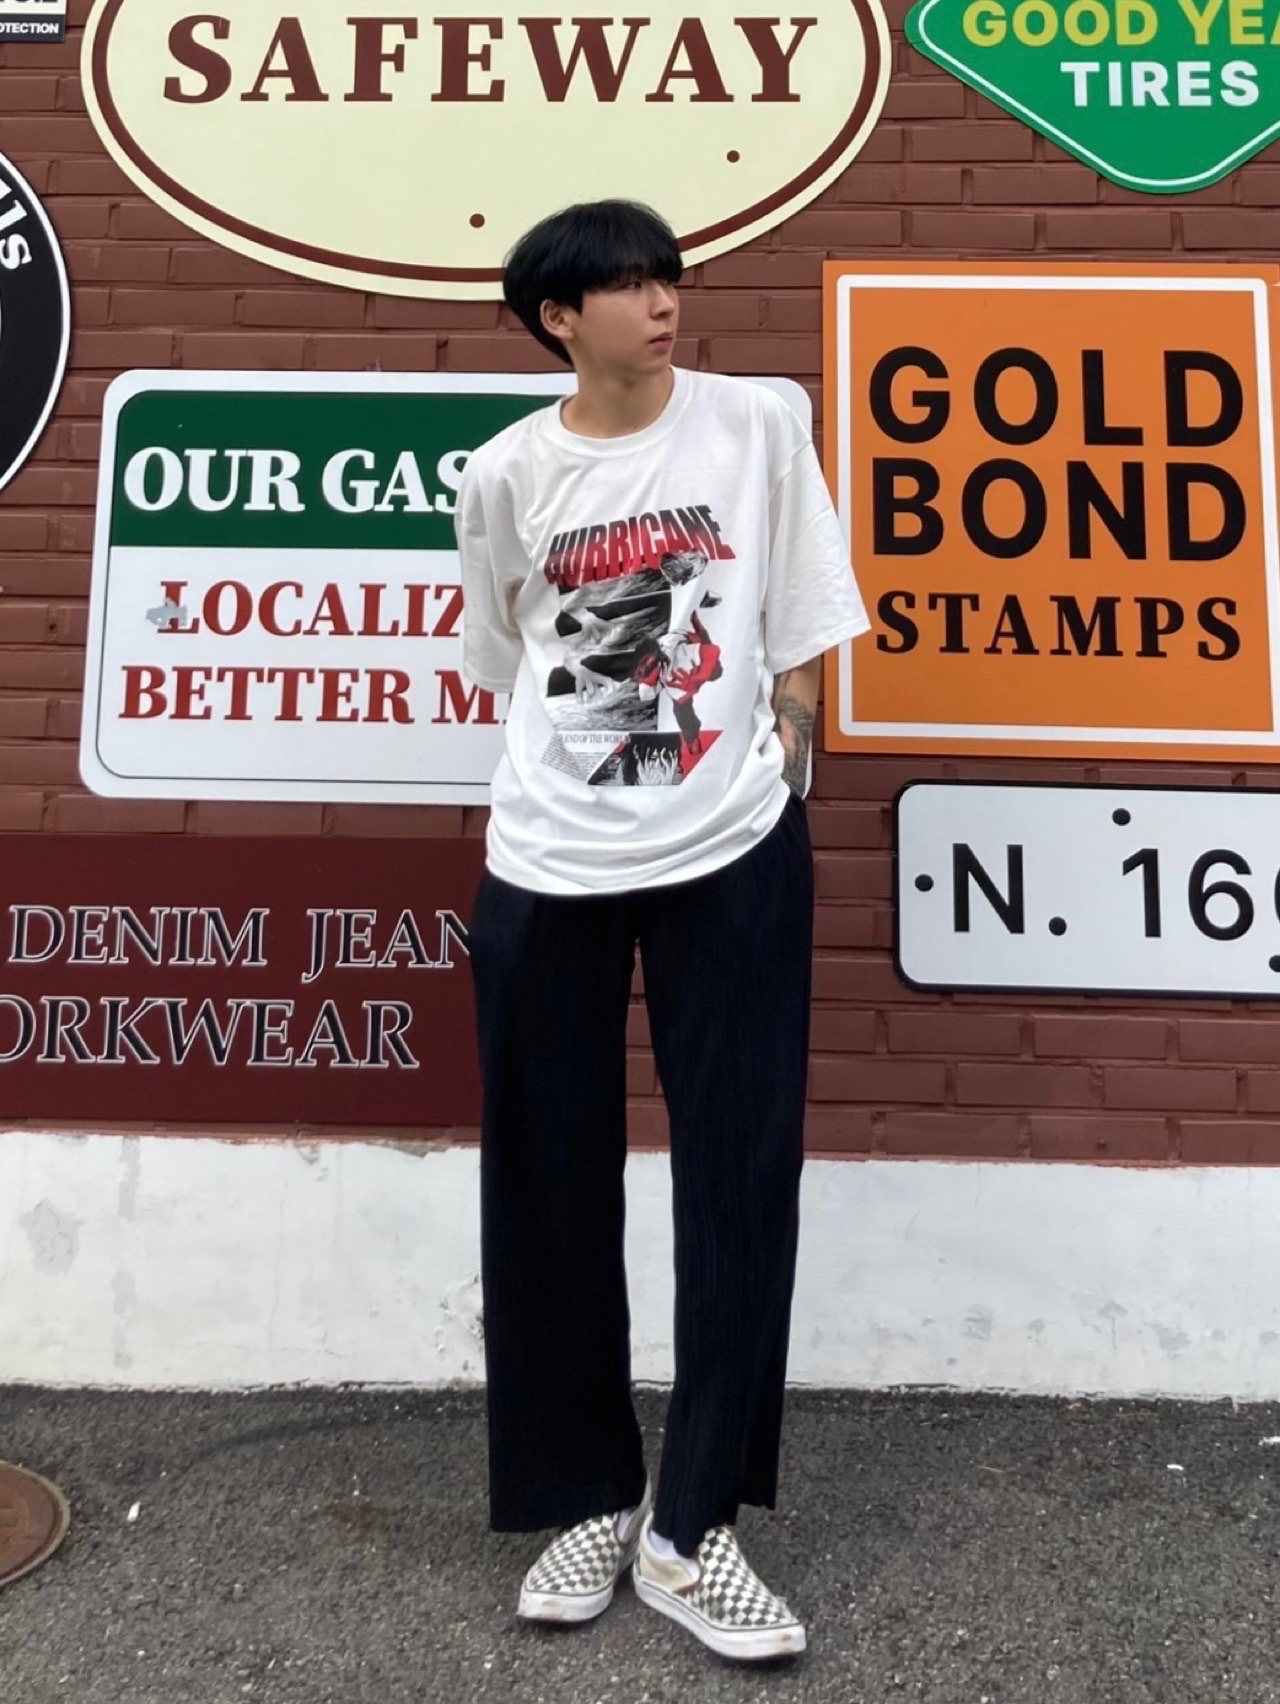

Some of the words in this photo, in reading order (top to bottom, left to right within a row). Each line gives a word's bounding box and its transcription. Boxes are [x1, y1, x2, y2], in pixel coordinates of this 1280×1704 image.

[163, 14, 818, 104] SAFEWAY
[962, 0, 1158, 47] GOOD
[1177, 0, 1280, 45] YE
[1060, 61, 1260, 107] TIRES
[869, 346, 1243, 448] GOLD
[124, 446, 305, 512] OUR
[322, 449, 474, 514] GAS
[872, 458, 1247, 562] BOND
[543, 504, 736, 587] HURRICANE
[157, 580, 464, 638] LOCALIZ
[876, 590, 1241, 661] STAMPS
[118, 665, 415, 724] BETTER
[431, 670, 512, 725] M
[1122, 848, 1280, 941] 16
[8, 905, 270, 967] DENIM
[302, 908, 470, 984] JEAN
